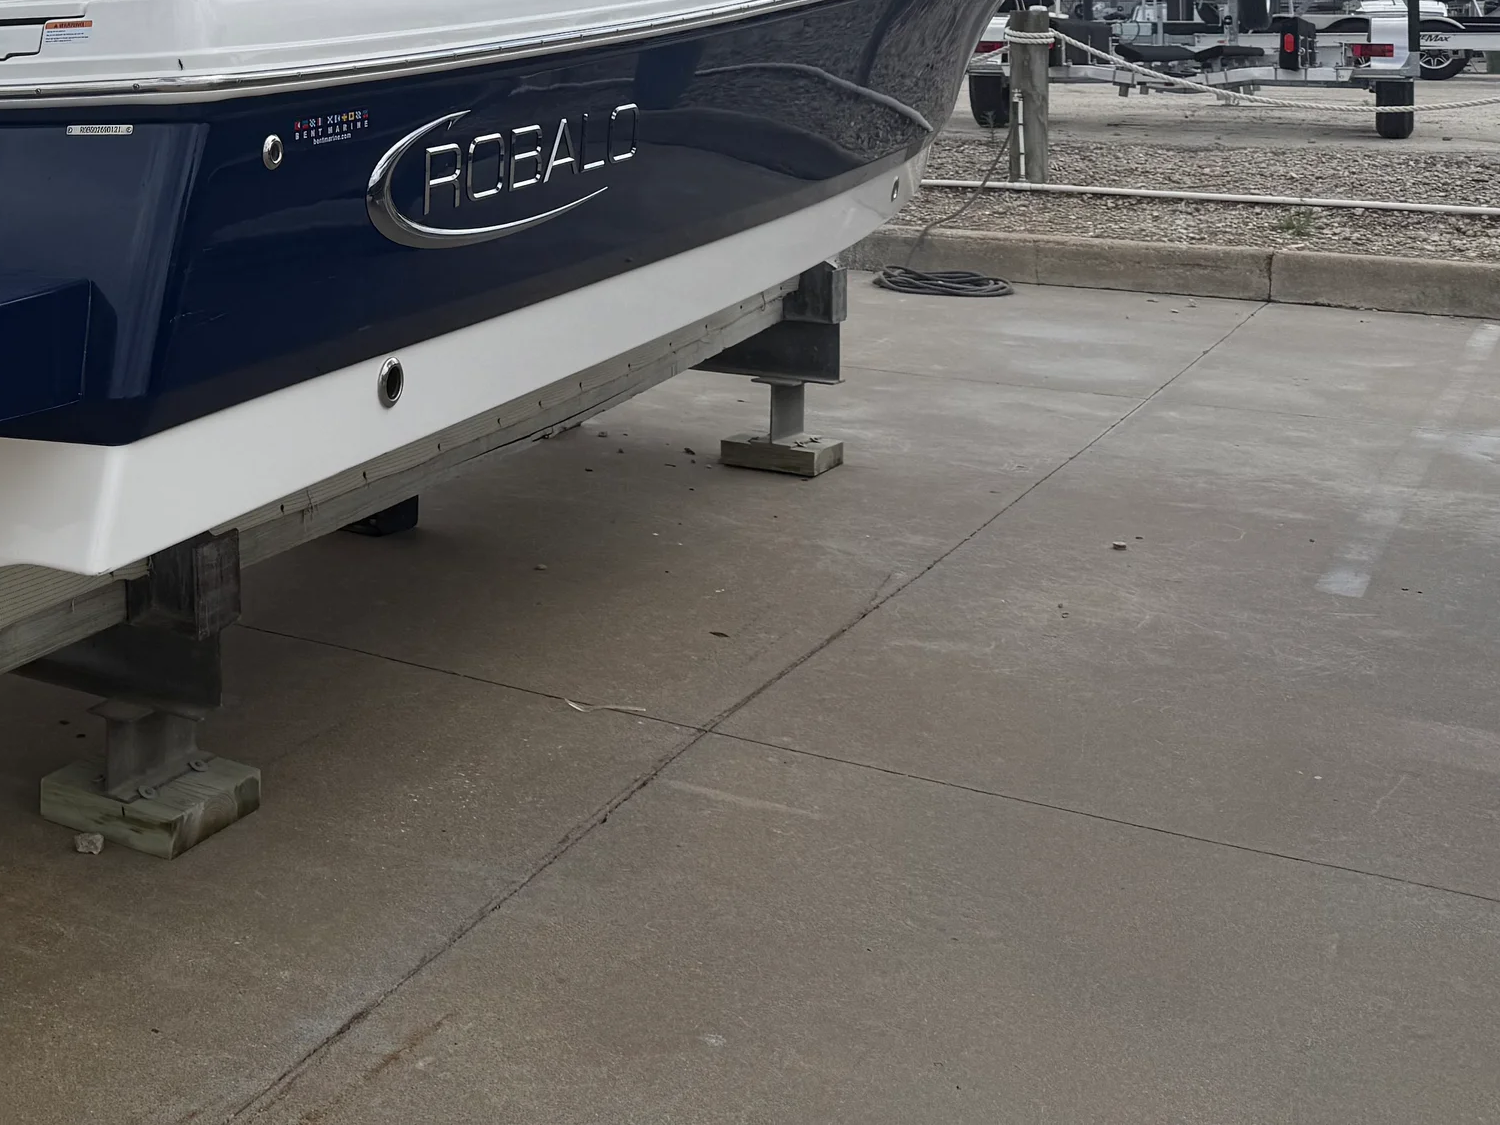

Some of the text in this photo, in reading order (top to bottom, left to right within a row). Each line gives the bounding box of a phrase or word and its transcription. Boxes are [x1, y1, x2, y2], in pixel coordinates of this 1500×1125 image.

[295, 120, 369, 140] BENT MARINE
[423, 103, 641, 216] ROBALO
